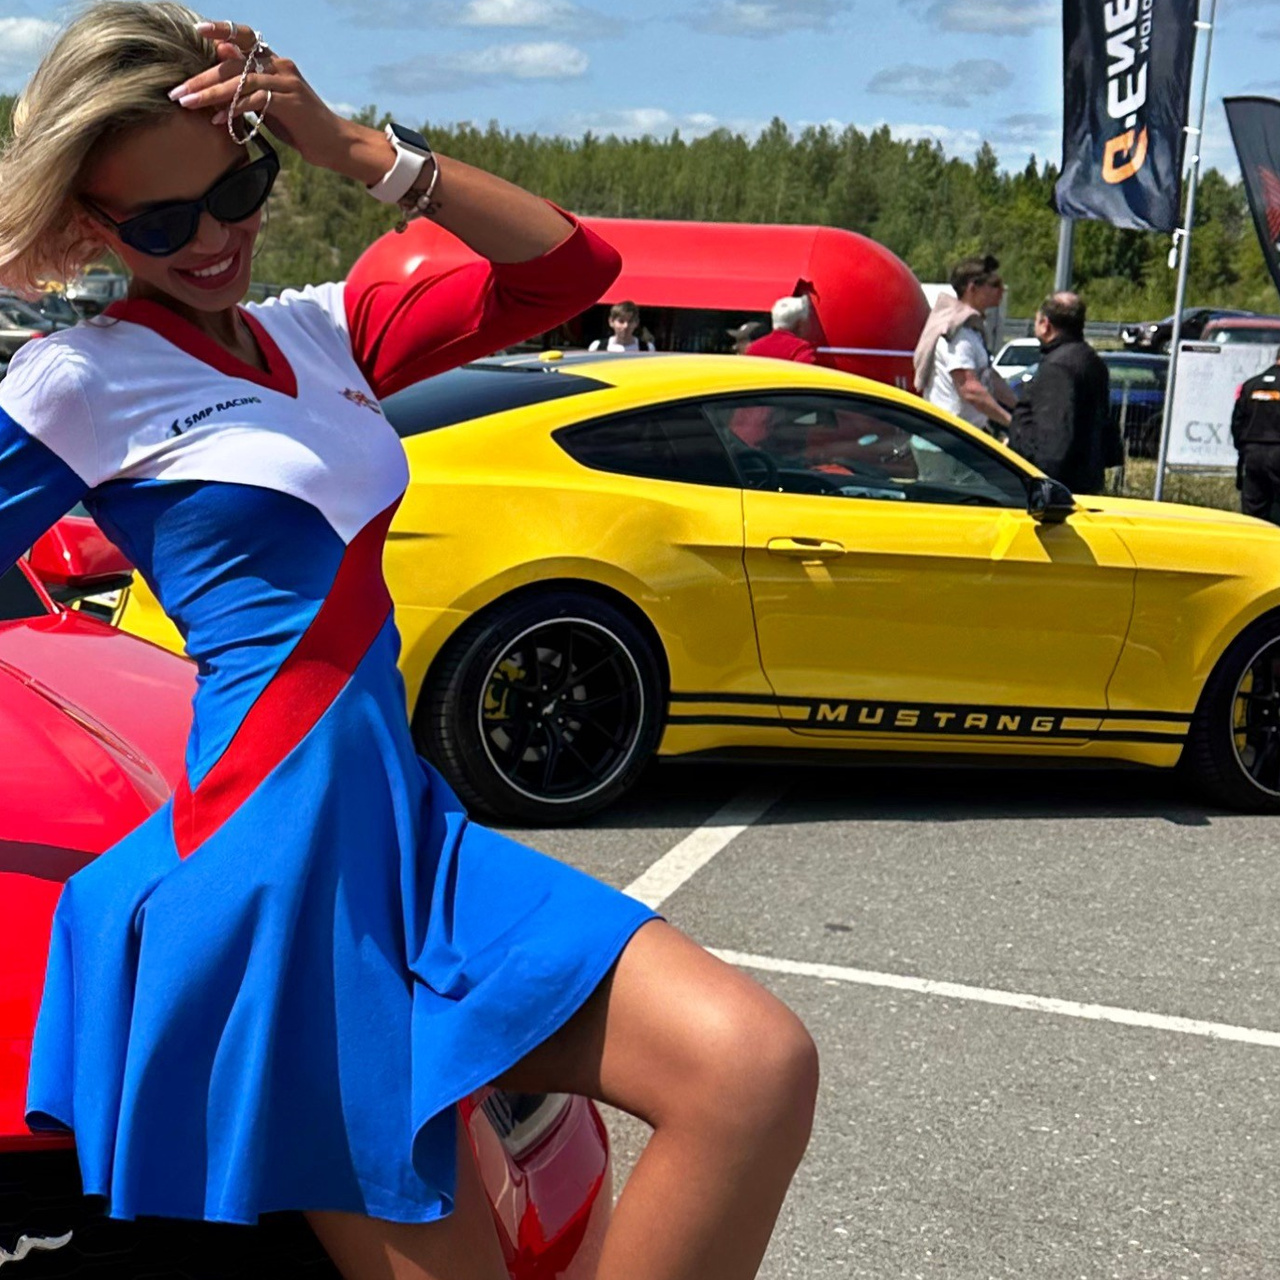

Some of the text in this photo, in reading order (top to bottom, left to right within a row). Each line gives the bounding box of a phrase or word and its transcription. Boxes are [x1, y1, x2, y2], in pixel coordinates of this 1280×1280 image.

[184, 396, 262, 428] SMP RACING
[816, 703, 1055, 732] MUSTANG
